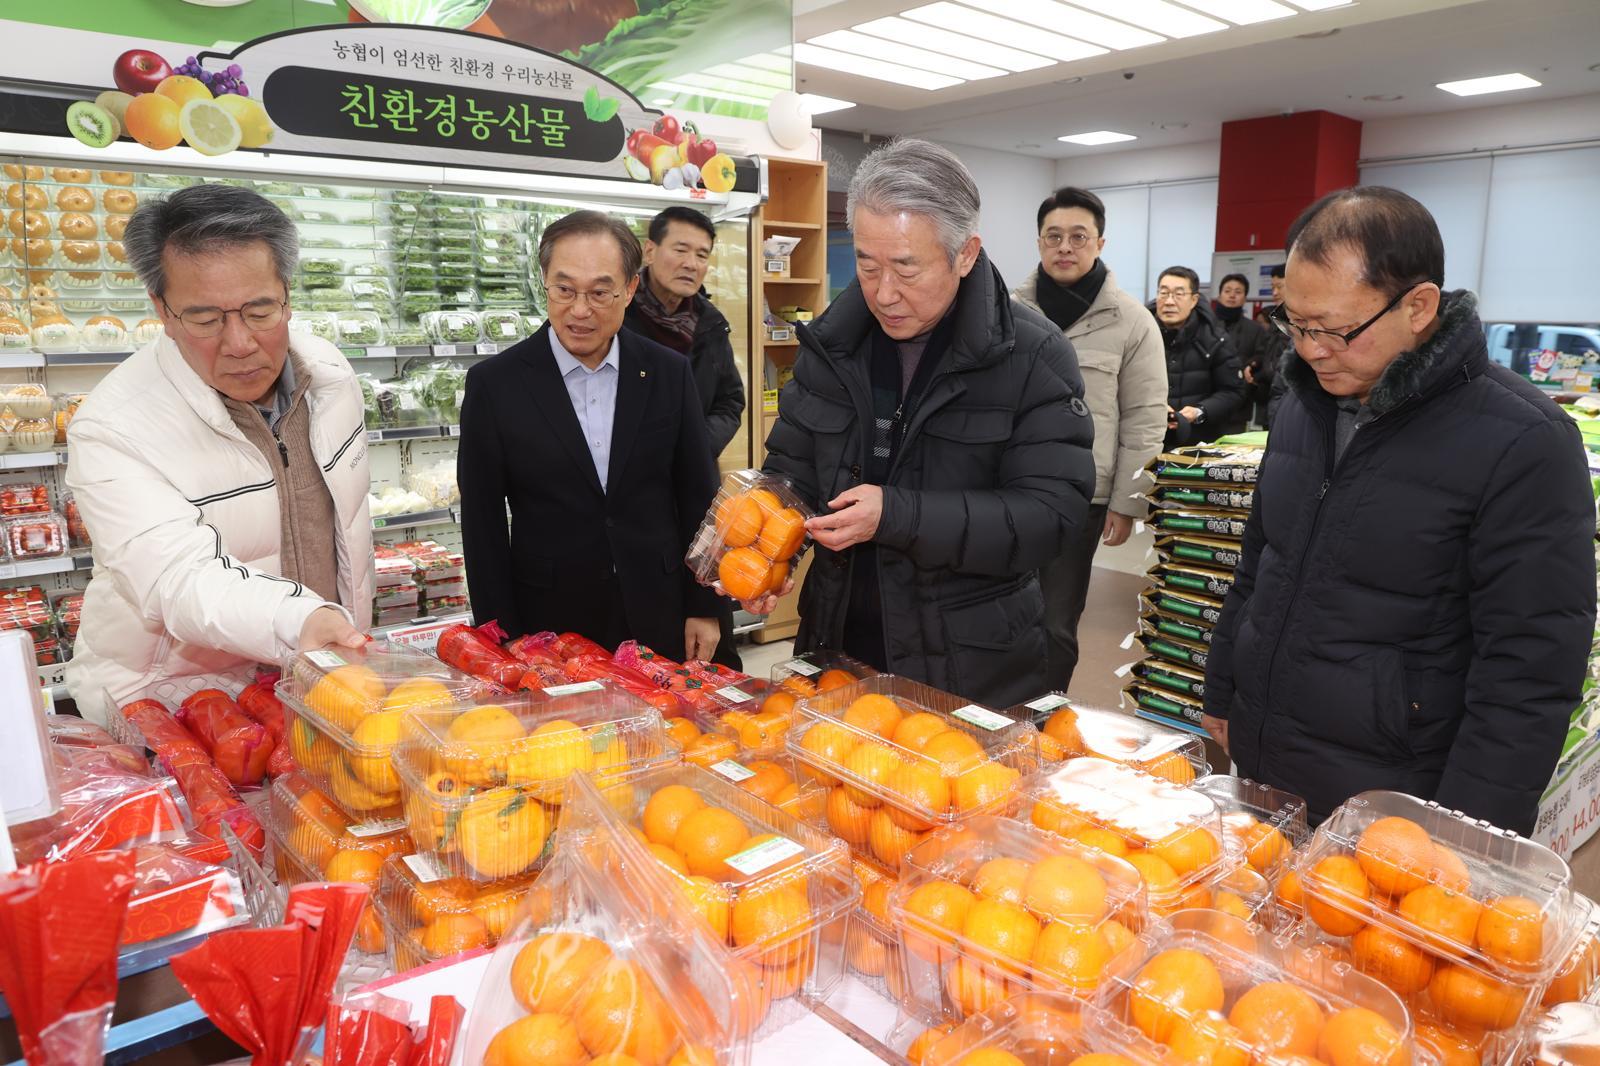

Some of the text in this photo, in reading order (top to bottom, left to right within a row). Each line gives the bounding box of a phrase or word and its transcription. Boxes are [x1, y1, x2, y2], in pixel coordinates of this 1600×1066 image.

[333, 40, 574, 90] 농협이 엄선한 친환경 우리농산물
[340, 84, 571, 147] 친환경농산물
